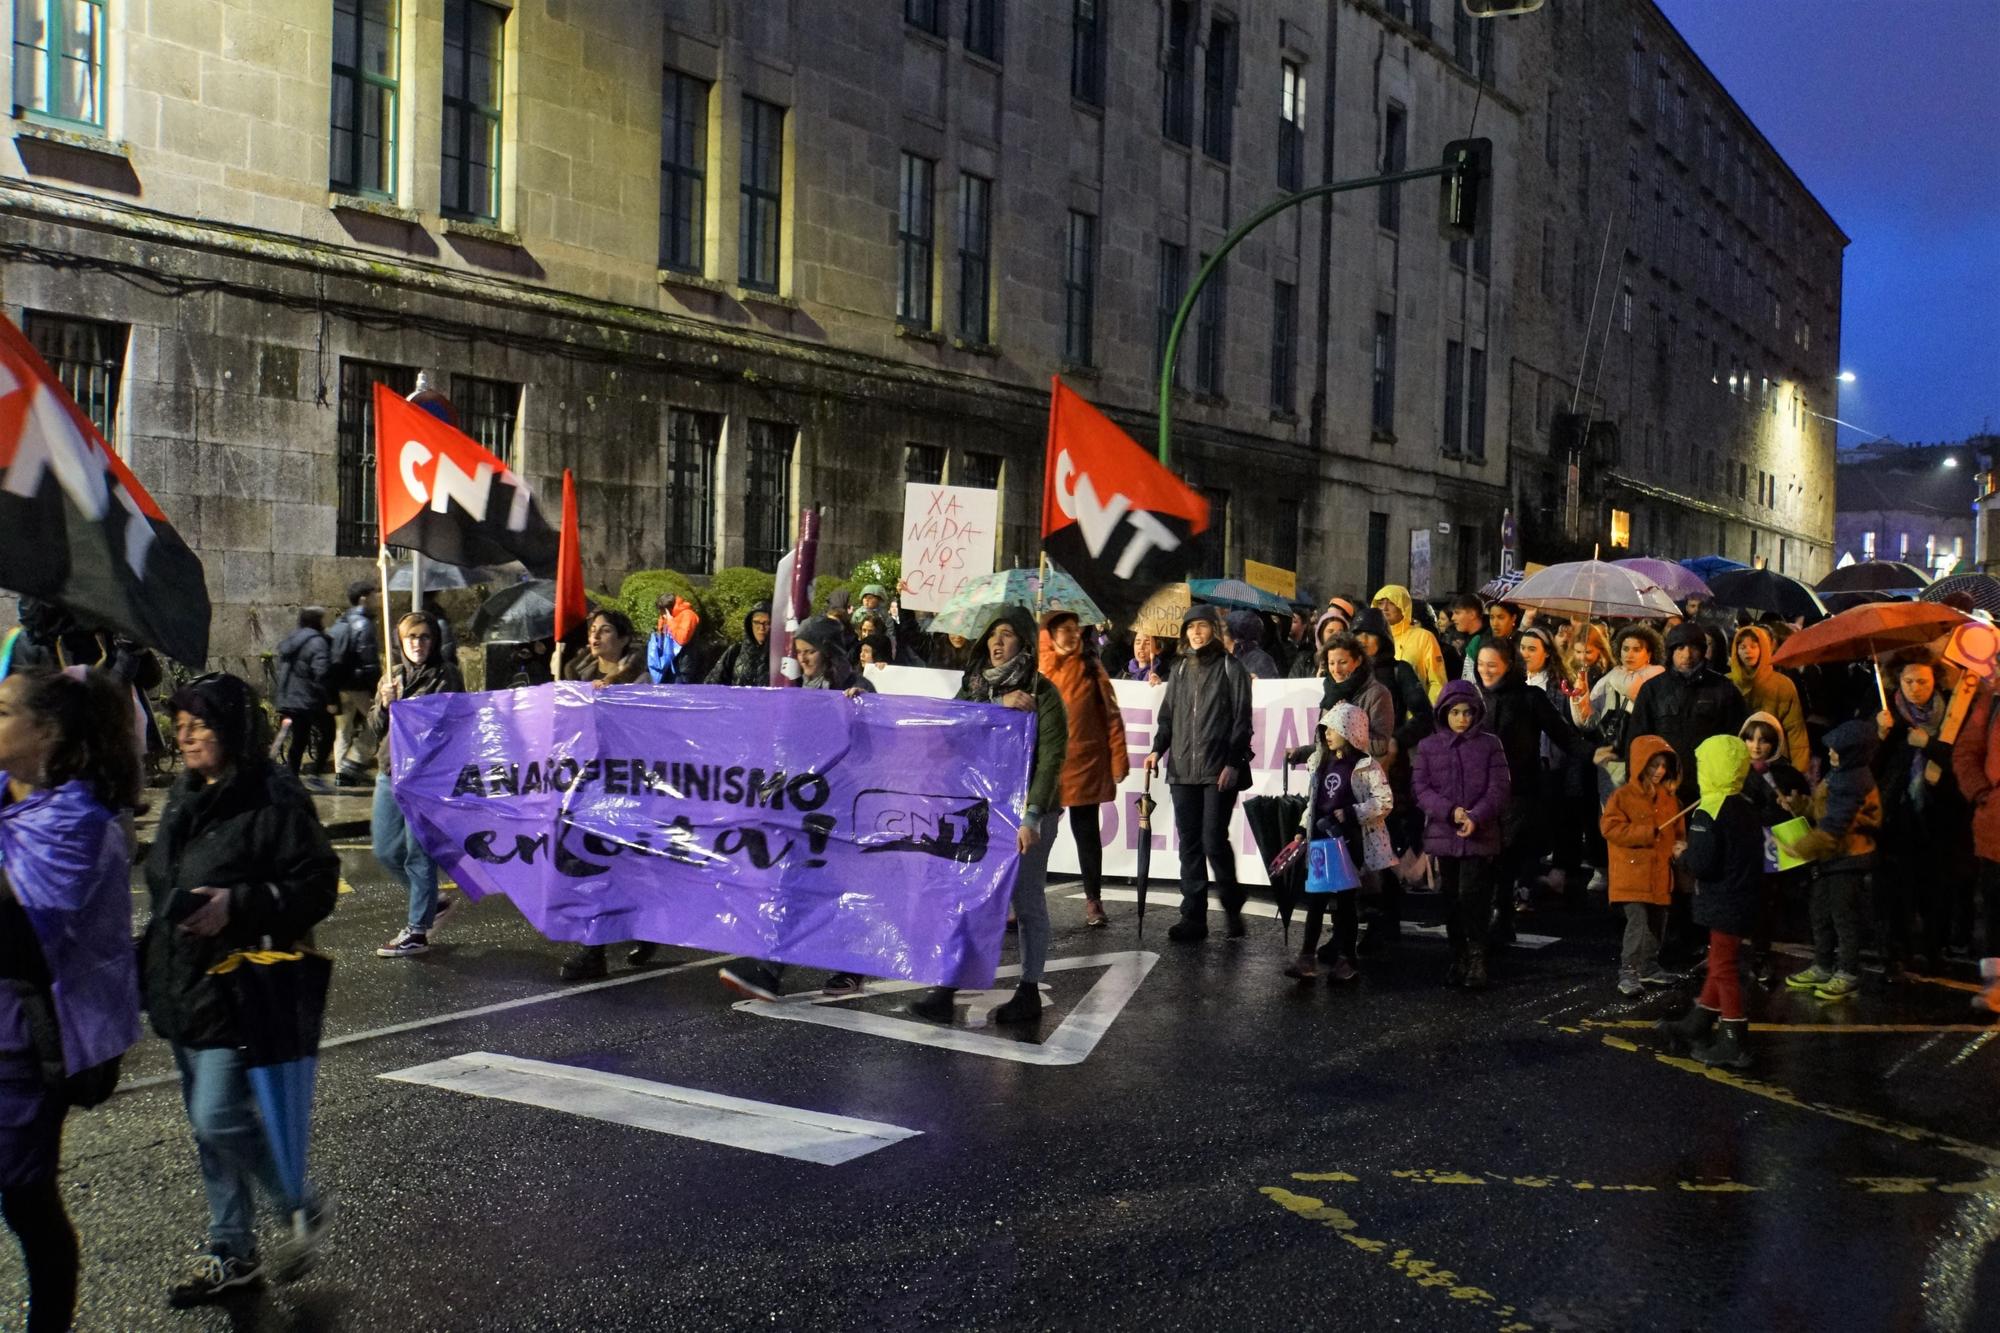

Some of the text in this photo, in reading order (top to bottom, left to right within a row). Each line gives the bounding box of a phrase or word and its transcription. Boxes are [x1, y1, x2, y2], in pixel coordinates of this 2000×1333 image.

[400, 440, 531, 532] CNT
[928, 490, 963, 515] XA
[1055, 448, 1181, 580] CNT
[908, 516, 984, 544] NADA
[920, 540, 967, 570] NOS
[875, 809, 969, 843] CNT
